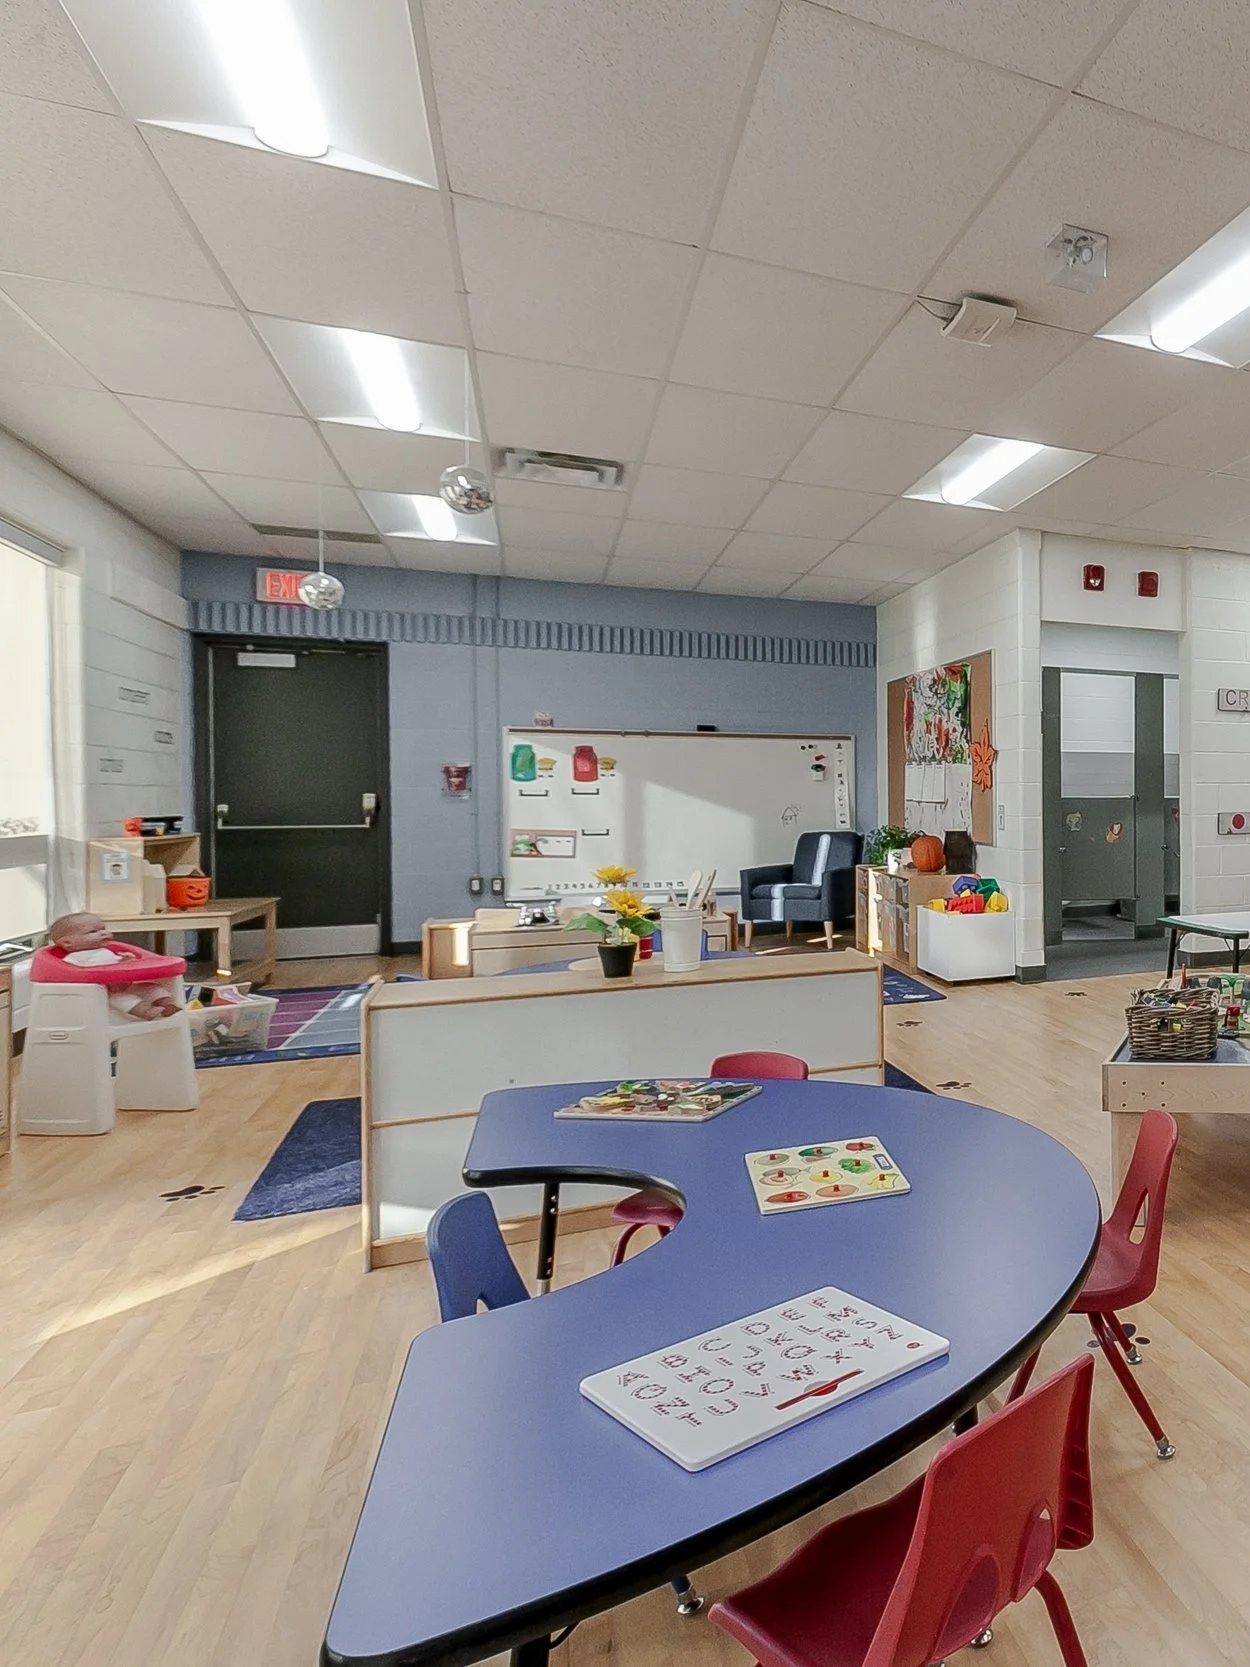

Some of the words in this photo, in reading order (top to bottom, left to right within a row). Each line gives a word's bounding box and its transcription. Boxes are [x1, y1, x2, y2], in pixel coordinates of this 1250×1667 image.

[619, 1371, 649, 1387] A
[660, 1354, 688, 1368] B
[700, 1338, 731, 1352] C
[742, 1322, 770, 1335] D
[779, 1308, 806, 1321] E
[810, 1297, 828, 1309] F
[653, 1397, 690, 1415] N
[701, 1378, 734, 1394] O
[745, 1361, 766, 1376] P
[782, 1345, 817, 1359] Q
[823, 1328, 850, 1342] R
[853, 1317, 877, 1329] S
[676, 1411, 702, 1426] T
[707, 1398, 738, 1415] U
[742, 1383, 771, 1398] V
[779, 1364, 817, 1381] W
[822, 1349, 852, 1364] X
[851, 1336, 874, 1350] Y
[876, 1324, 902, 1340] Z
[677, 1365, 711, 1382] H
[742, 1345, 762, 1359] J
[766, 1331, 793, 1346] K
[797, 1324, 824, 1335] L
[825, 1305, 859, 1321] M
